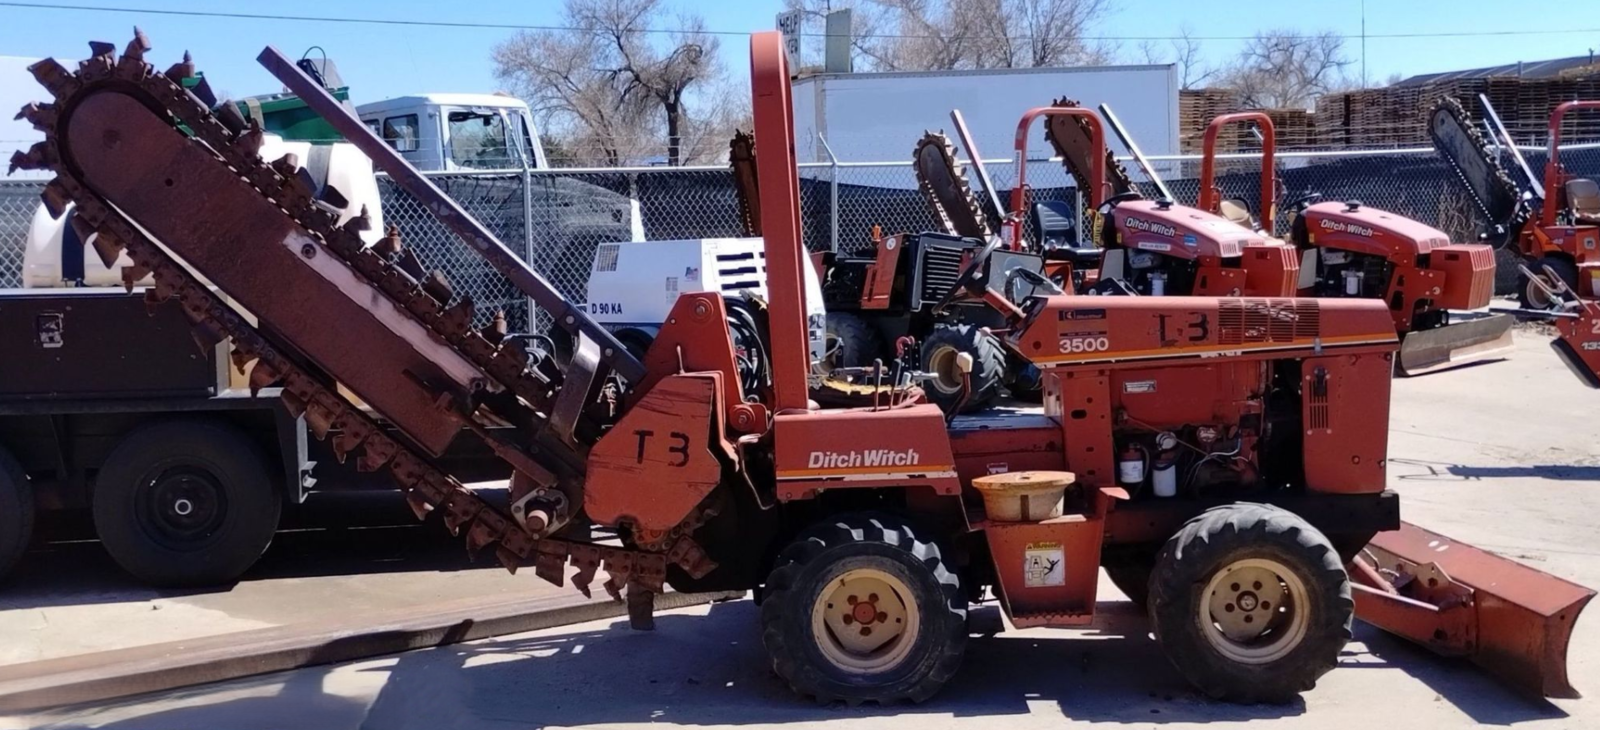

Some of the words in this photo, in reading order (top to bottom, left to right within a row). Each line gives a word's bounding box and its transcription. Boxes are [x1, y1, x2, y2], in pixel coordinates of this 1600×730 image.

[1126, 217, 1149, 231] Ditch
[1150, 222, 1176, 237] Witch
[1320, 219, 1345, 231] Ditch
[1347, 224, 1374, 237] Witch
[591, 303, 598, 314] D
[599, 303, 609, 314] 90
[611, 303, 623, 314] KA
[1059, 337, 1109, 354] 3500
[808, 451, 862, 469] Ditch
[863, 449, 920, 466] Witch
